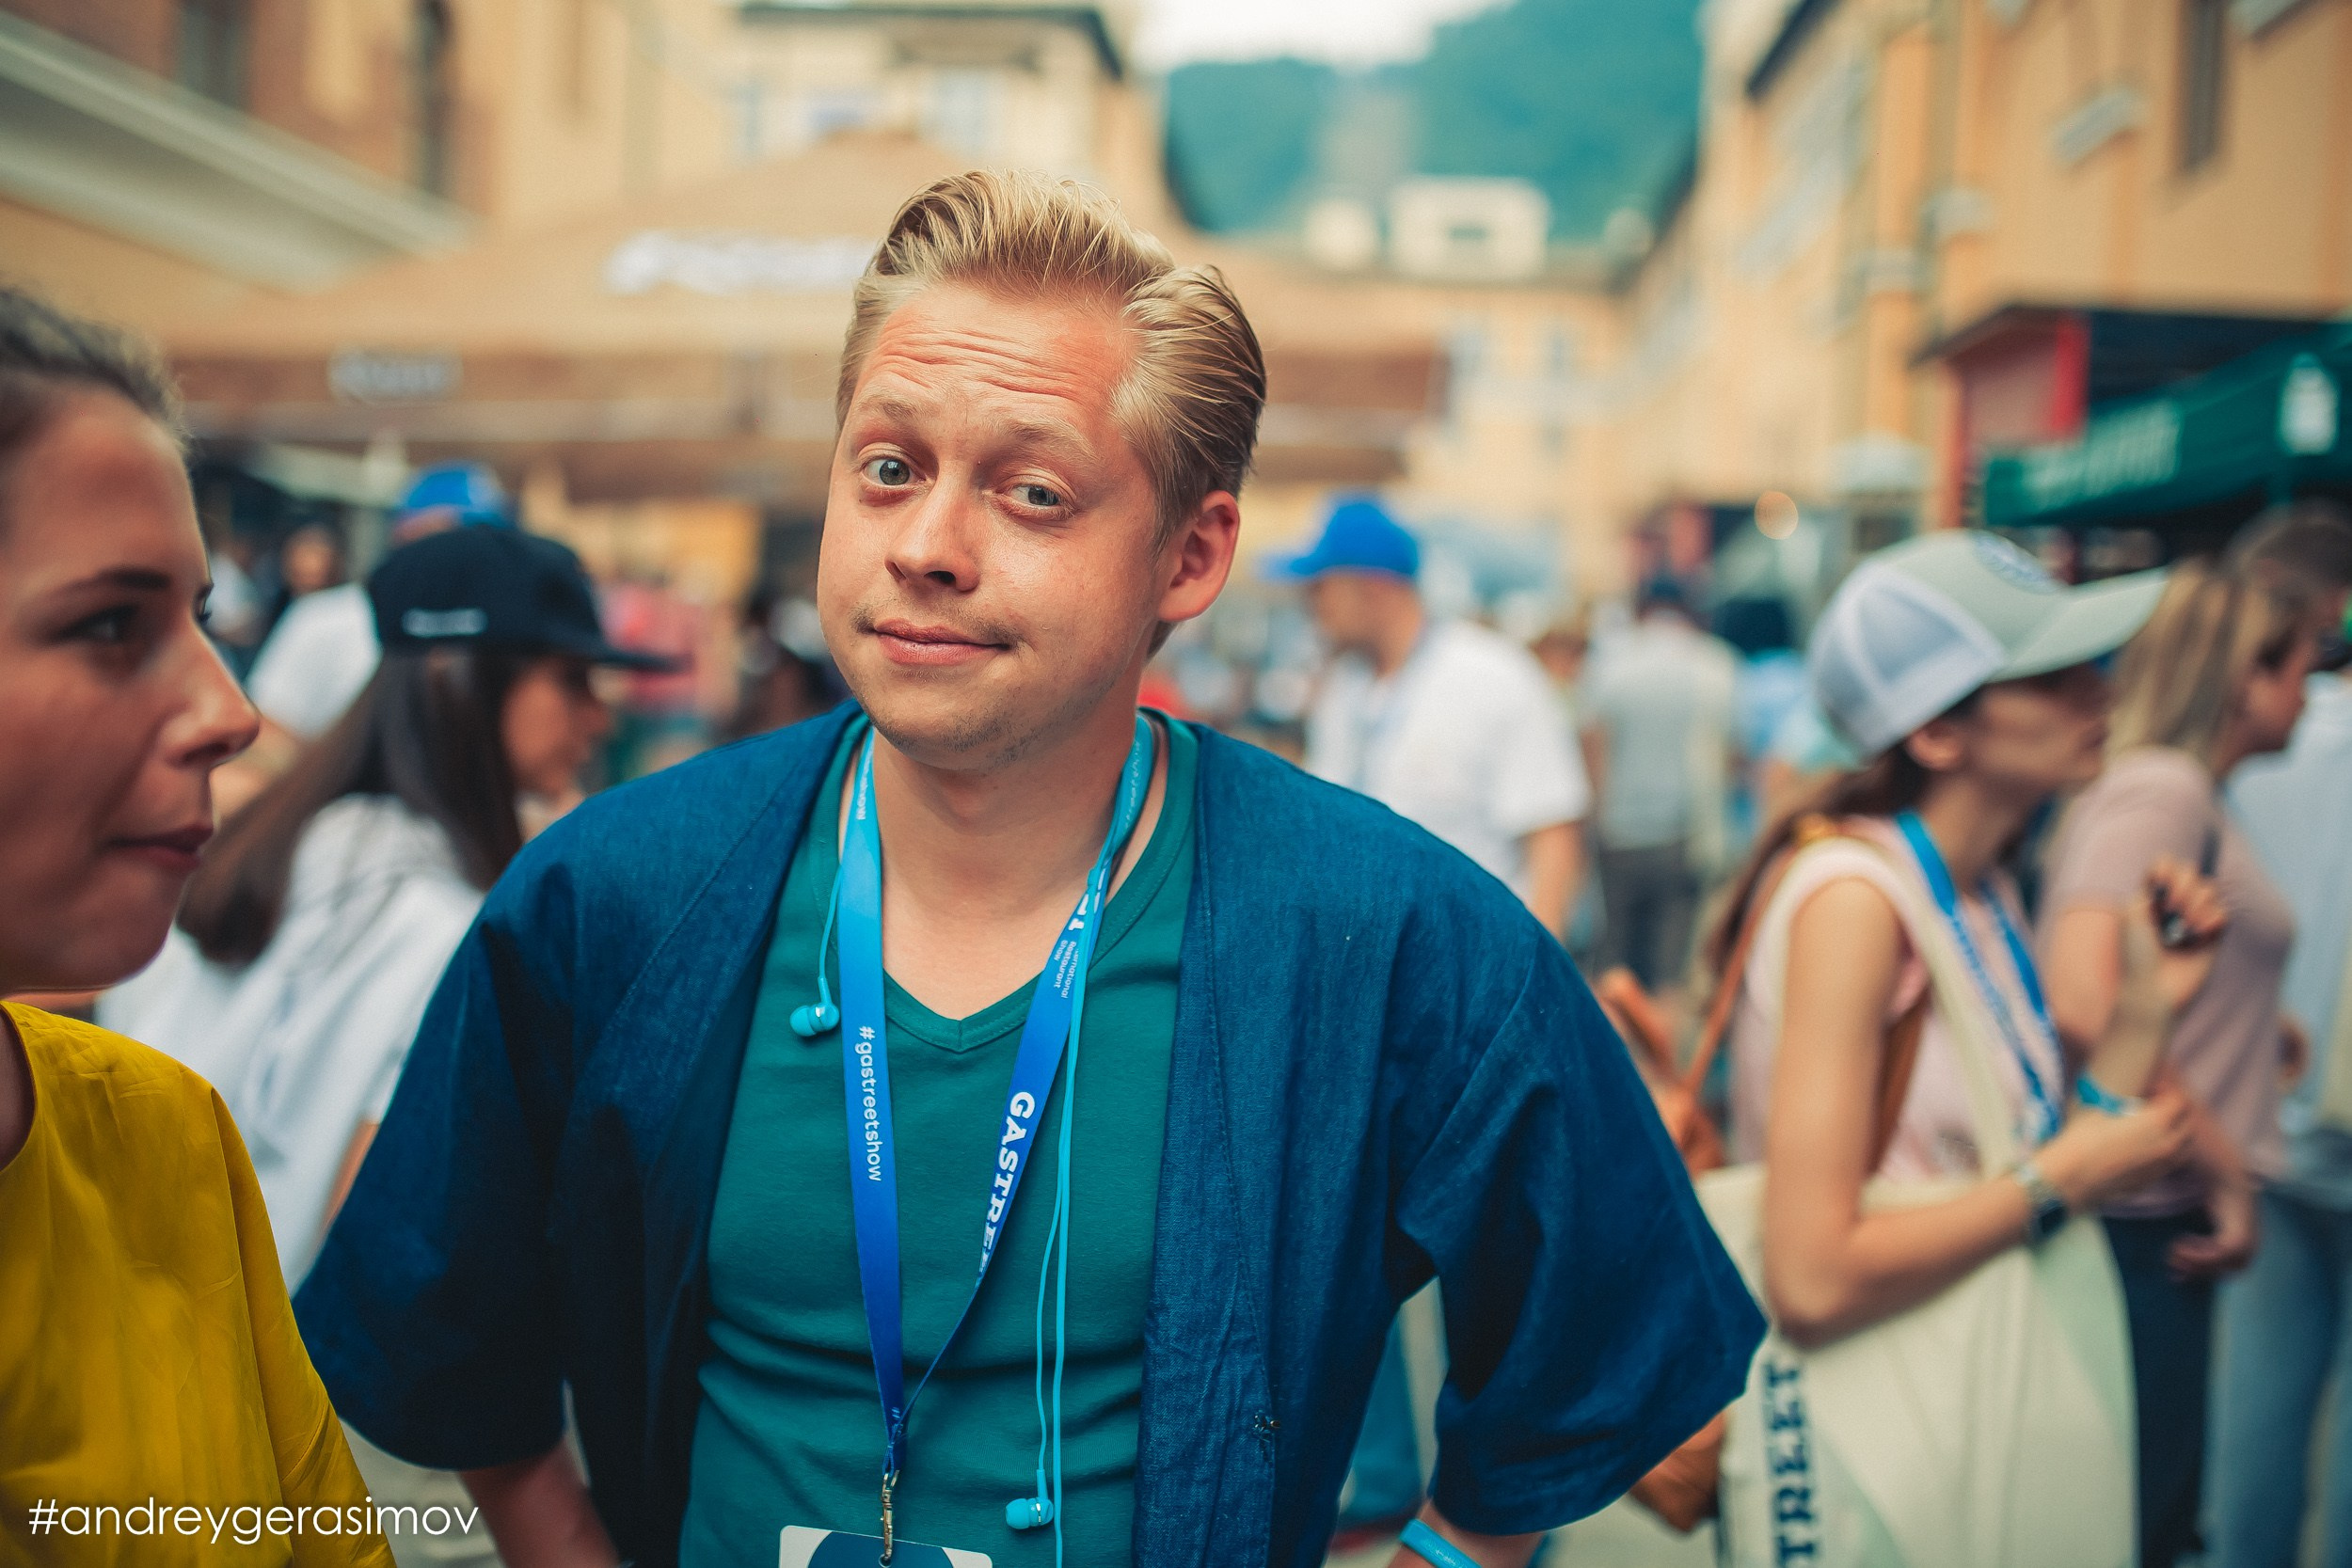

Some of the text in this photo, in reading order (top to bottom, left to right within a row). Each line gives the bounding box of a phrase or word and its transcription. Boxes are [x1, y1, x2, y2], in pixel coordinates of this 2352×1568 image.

[1054, 940, 1068, 961] Show
[1054, 941, 1077, 989] Restaurant
[1061, 948, 1079, 999] ernational
[855, 1026, 883, 1182] #gastreetshow
